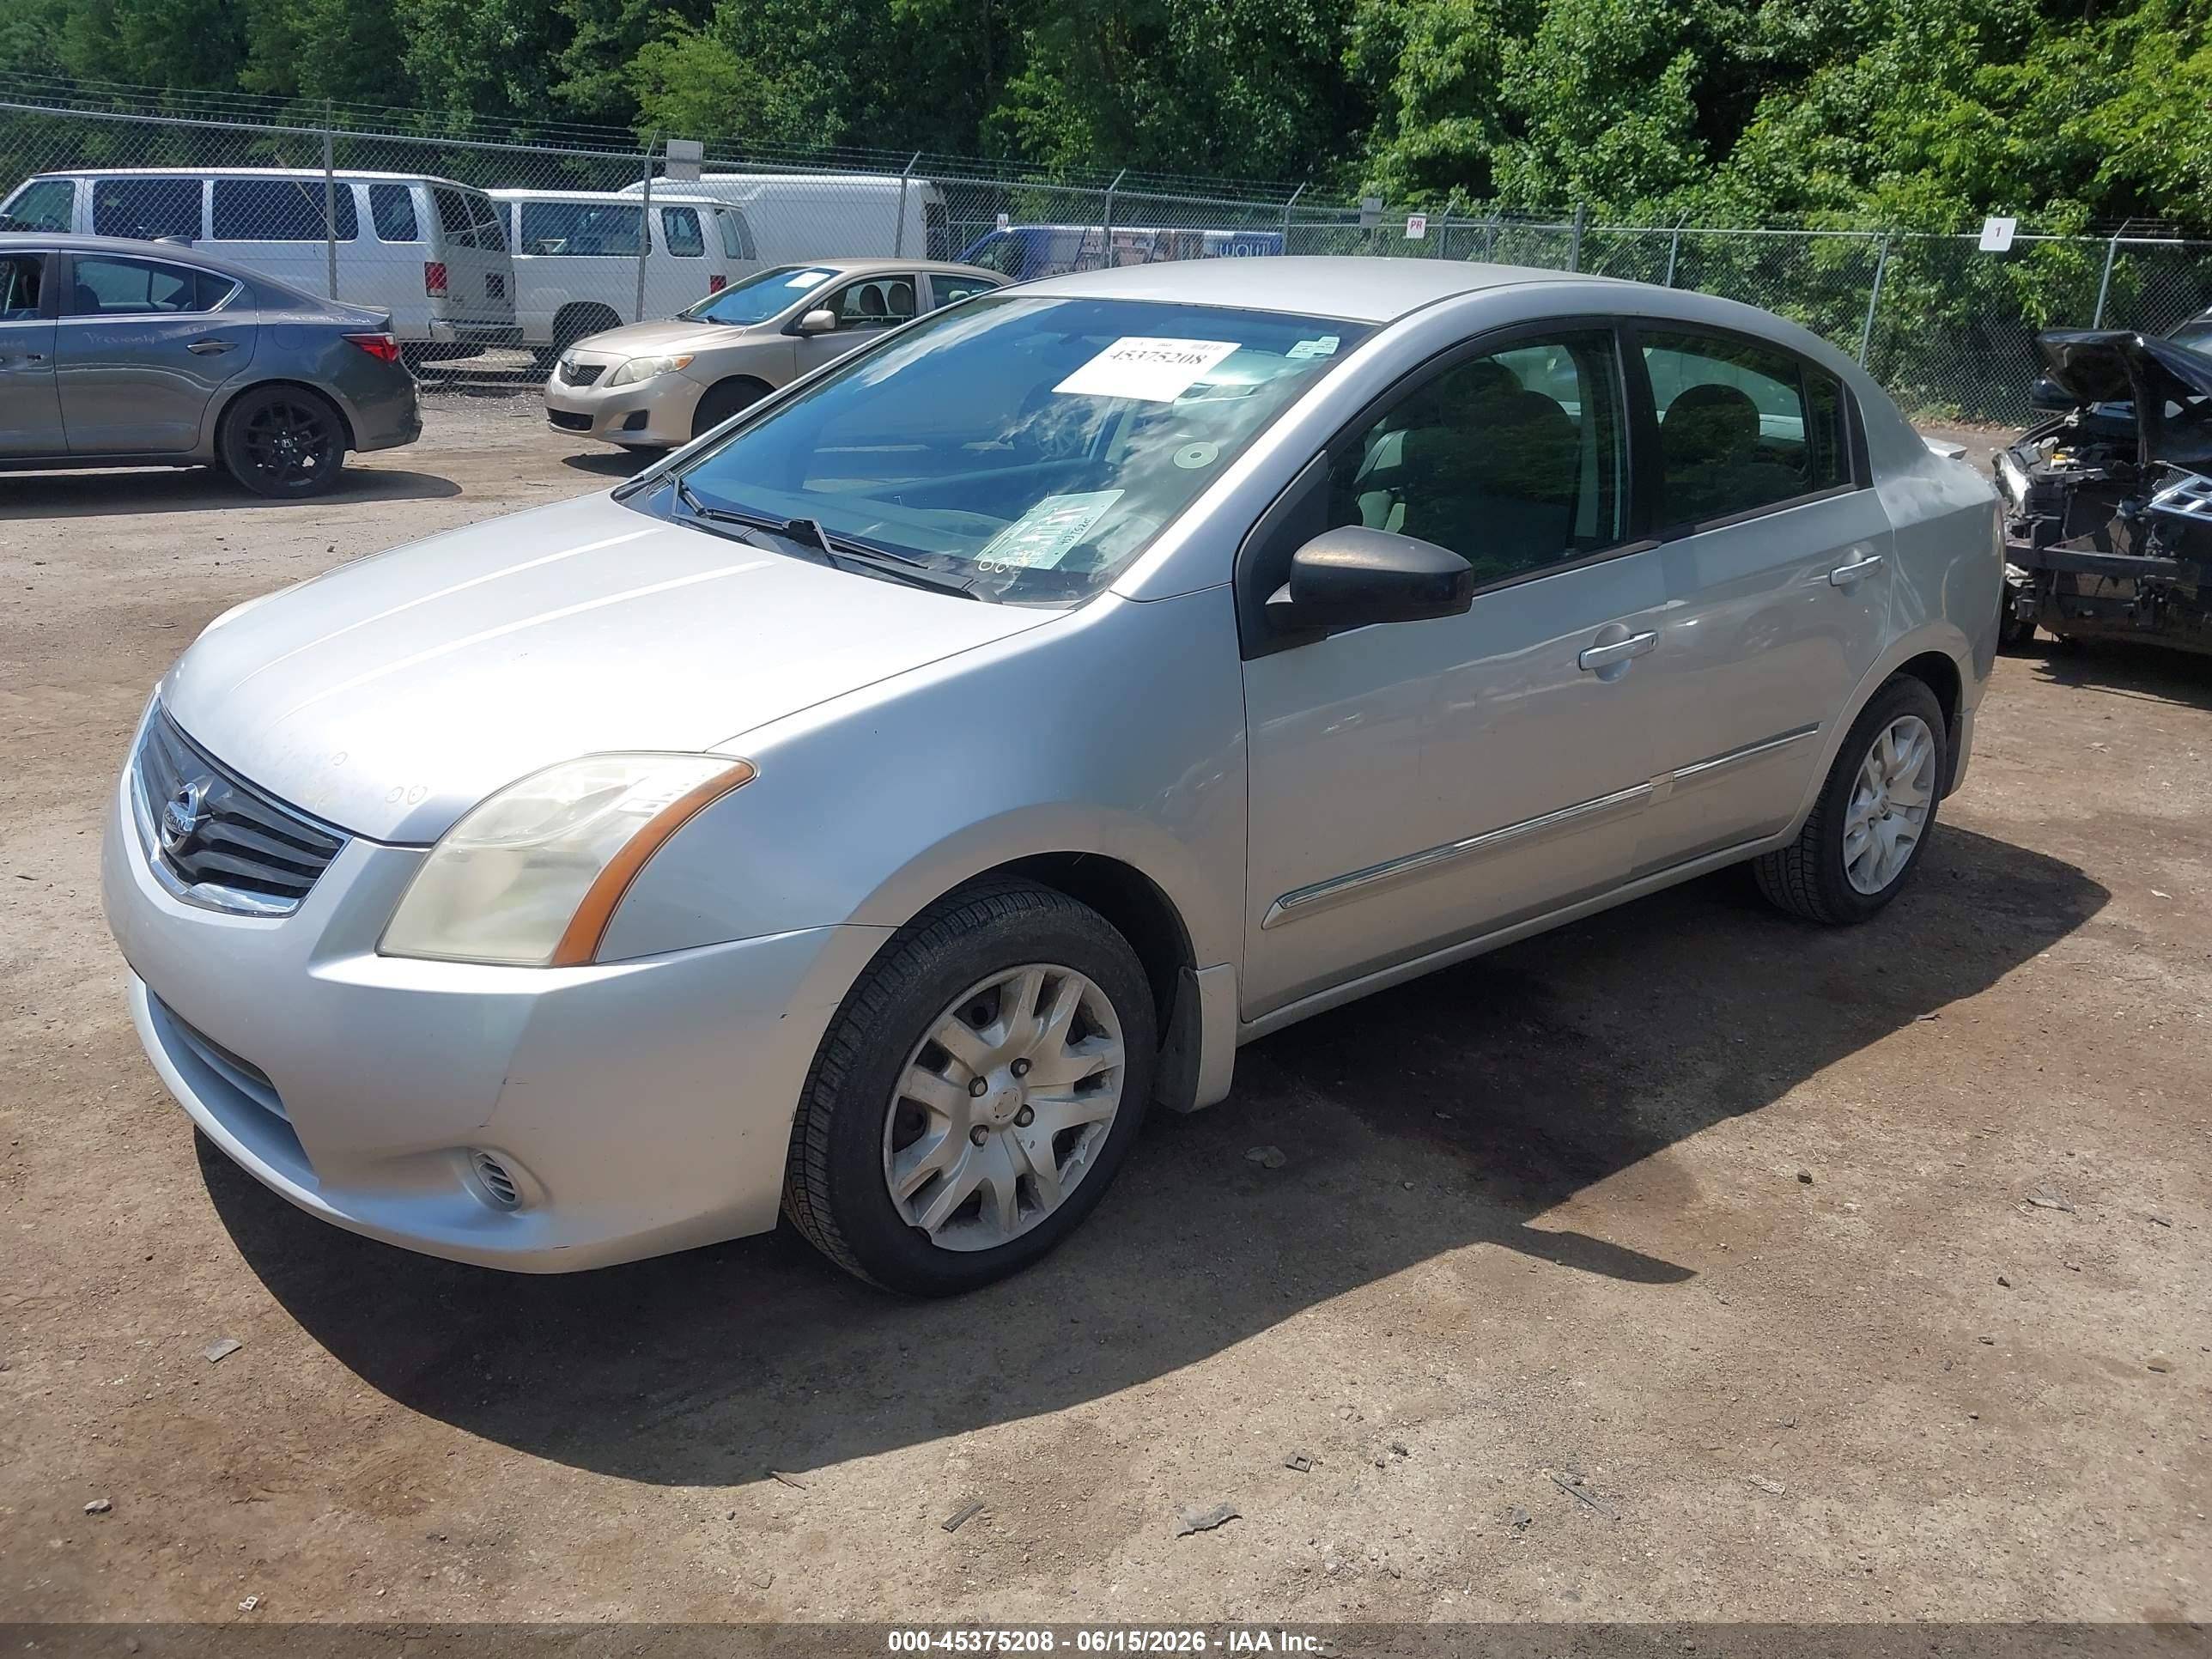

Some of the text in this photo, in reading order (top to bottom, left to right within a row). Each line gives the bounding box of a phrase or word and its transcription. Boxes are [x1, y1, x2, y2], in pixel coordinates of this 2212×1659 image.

[1411, 220, 1424, 230] PR
[1995, 226, 2002, 238] 1
[1109, 349, 1207, 365] 45375208
